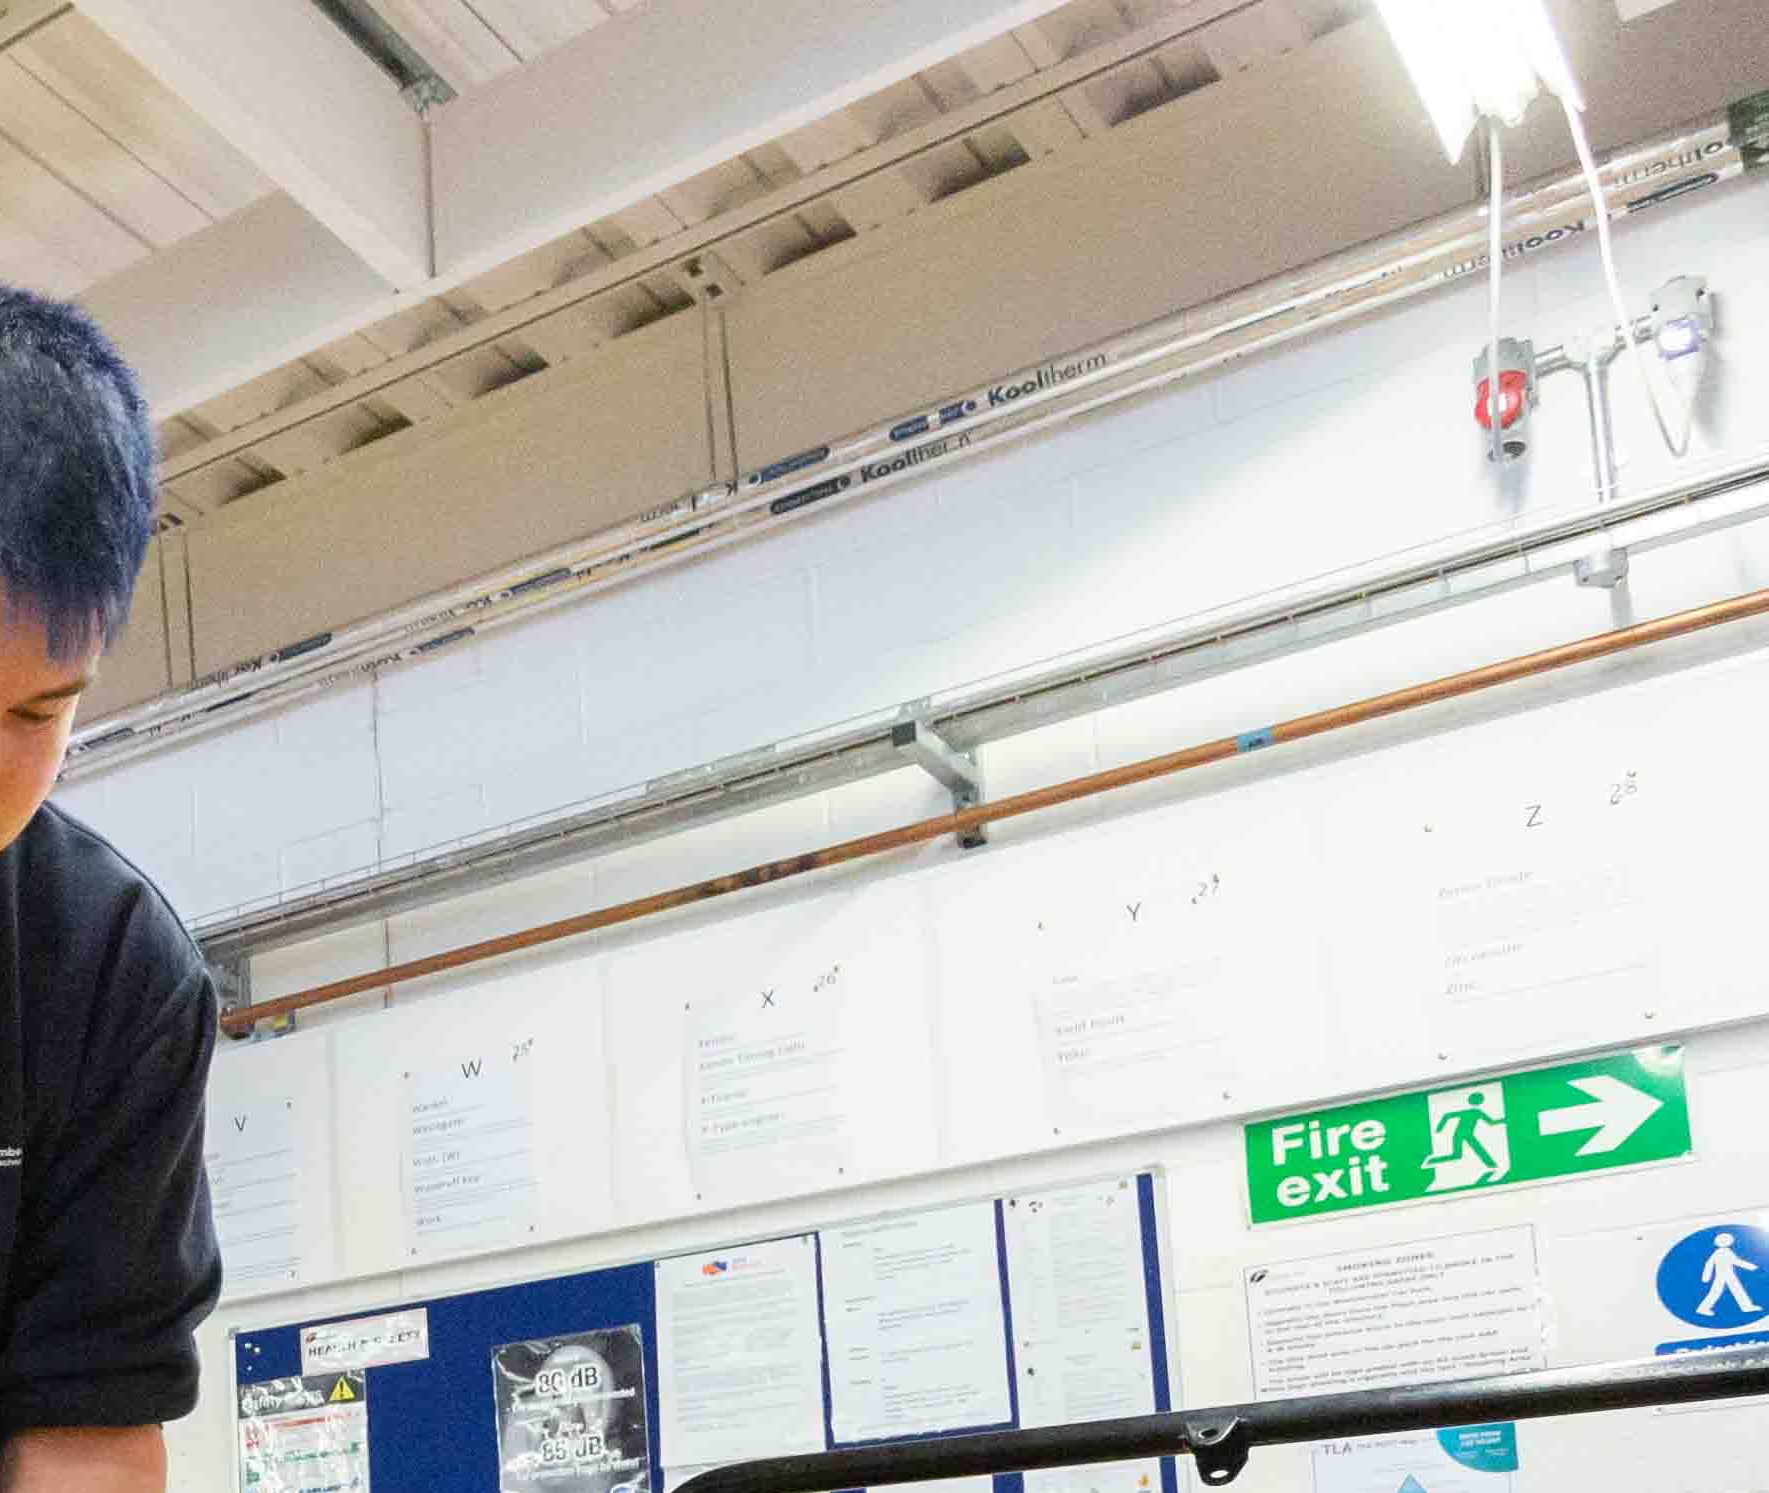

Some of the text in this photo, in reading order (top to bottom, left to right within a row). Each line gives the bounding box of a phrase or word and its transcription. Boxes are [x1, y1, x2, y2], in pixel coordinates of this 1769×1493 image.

[988, 353, 1107, 406] Kooltherm
[1524, 803, 1545, 828] Z
[1125, 901, 1142, 923] Y
[761, 990, 775, 1009] X
[461, 1058, 483, 1079] W
[234, 1115, 247, 1132] V
[1272, 1119, 1387, 1167] Fire
[1277, 1154, 1390, 1208] exit
[570, 1365, 599, 1390] dB
[1324, 1443, 1352, 1456] TLA
